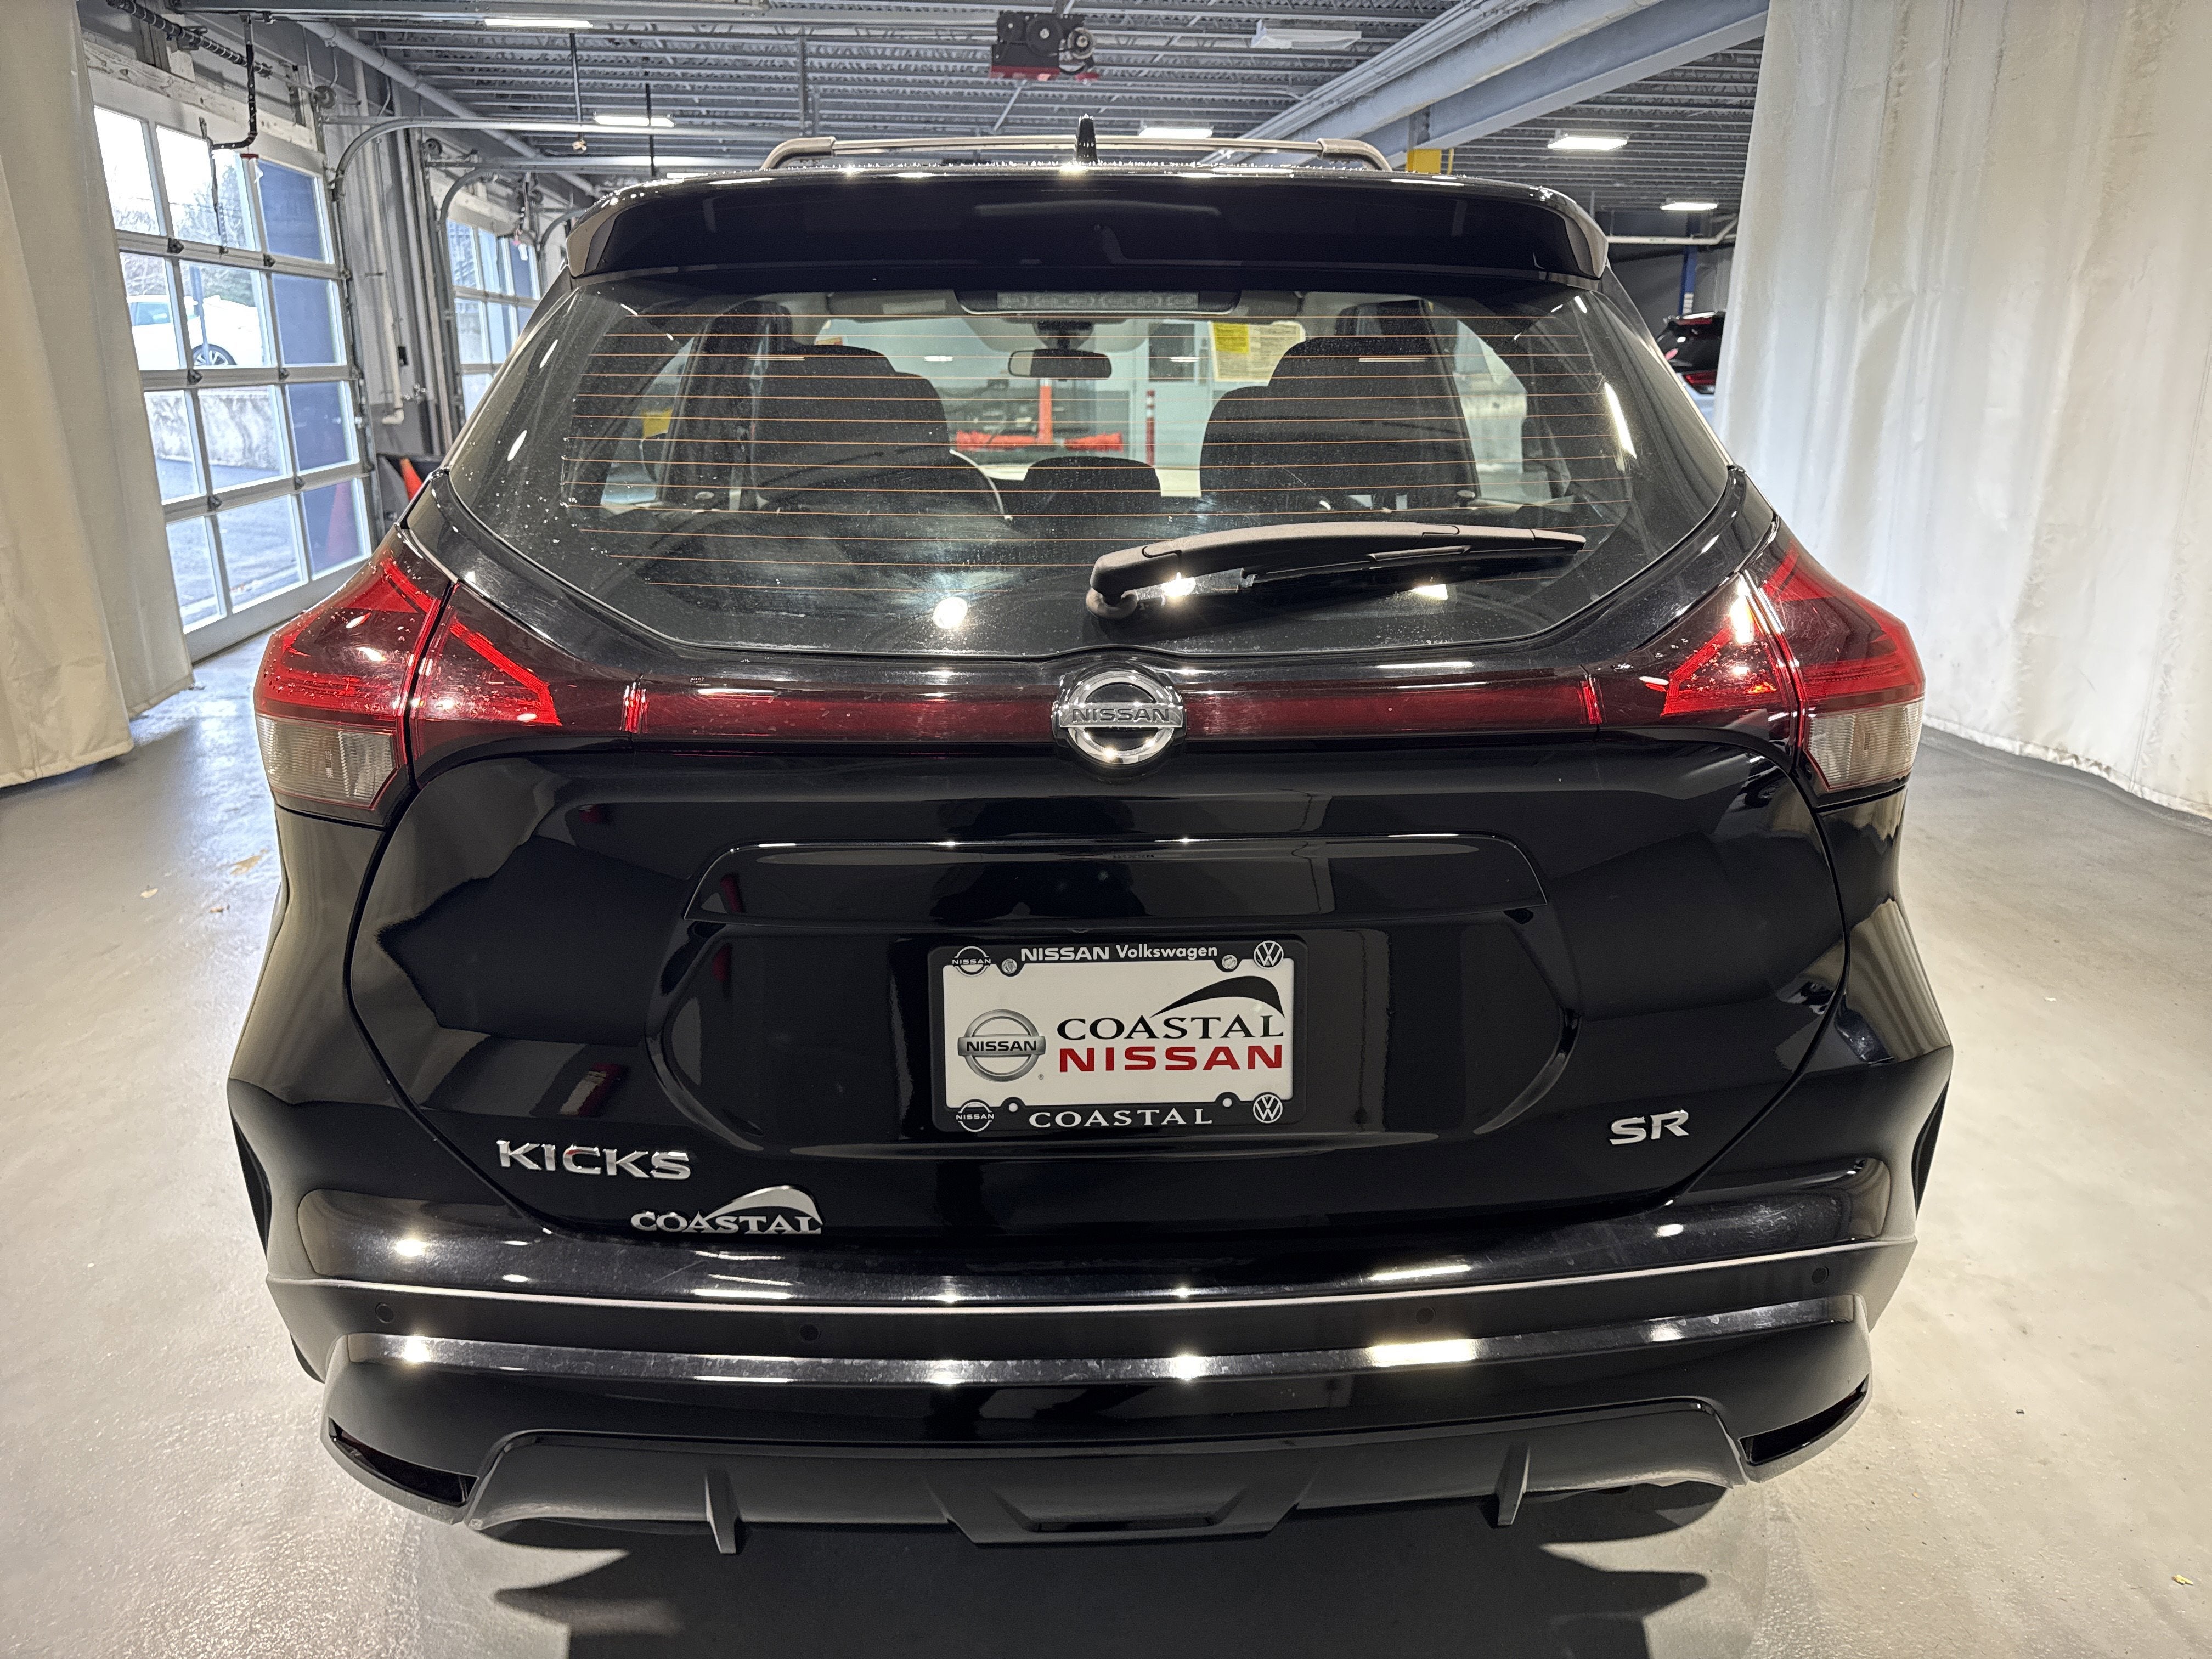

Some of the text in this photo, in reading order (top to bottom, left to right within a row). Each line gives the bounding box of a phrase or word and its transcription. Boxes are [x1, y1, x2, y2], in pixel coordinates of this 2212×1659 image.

[1073, 708, 1169, 723] NISSAN
[1021, 944, 1217, 961] NISSAN Volkswagen
[1057, 1014, 1284, 1040] COASTAL
[967, 1040, 1037, 1052] NISSAN
[1059, 1045, 1282, 1072] NISSAN
[1029, 1108, 1212, 1127] COASTAL
[1609, 1109, 1689, 1145] SR
[496, 1140, 691, 1180] KICKS
[631, 1211, 822, 1235] COASTAL
